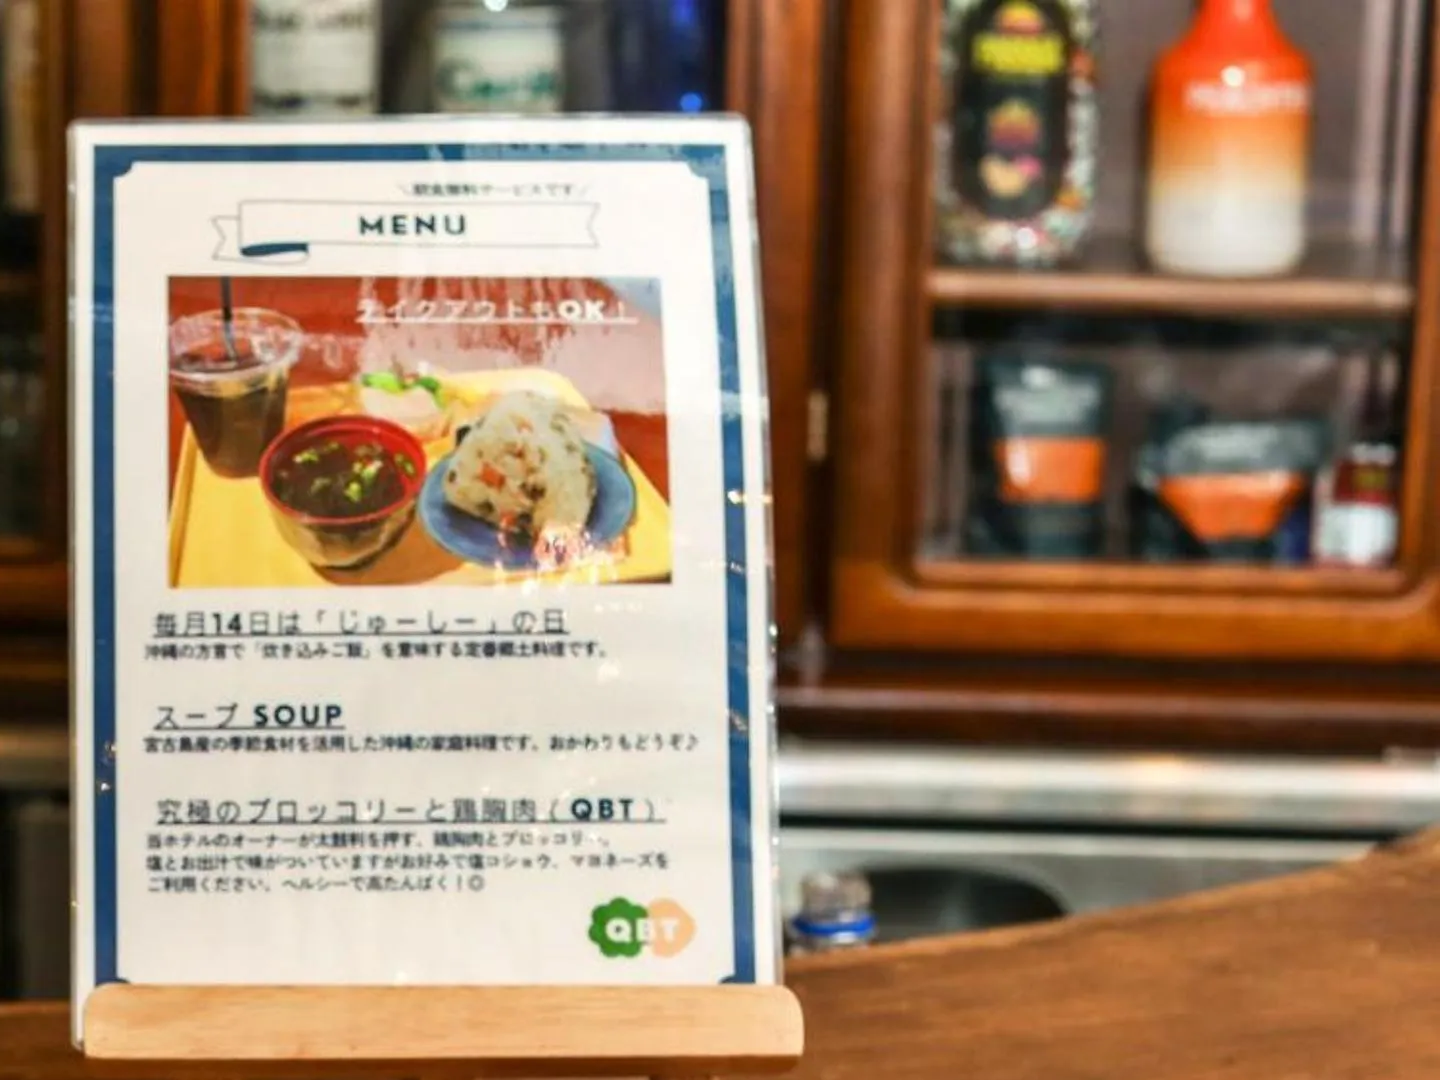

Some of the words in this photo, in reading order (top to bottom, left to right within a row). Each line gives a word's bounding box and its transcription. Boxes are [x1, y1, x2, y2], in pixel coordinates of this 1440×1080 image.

[358, 213, 466, 236] MENU
[154, 609, 566, 635] 毎月14日は「じゅーしー」の日
[154, 702, 239, 728] スープ
[253, 704, 343, 727] SOUP
[604, 916, 680, 945] QBT
